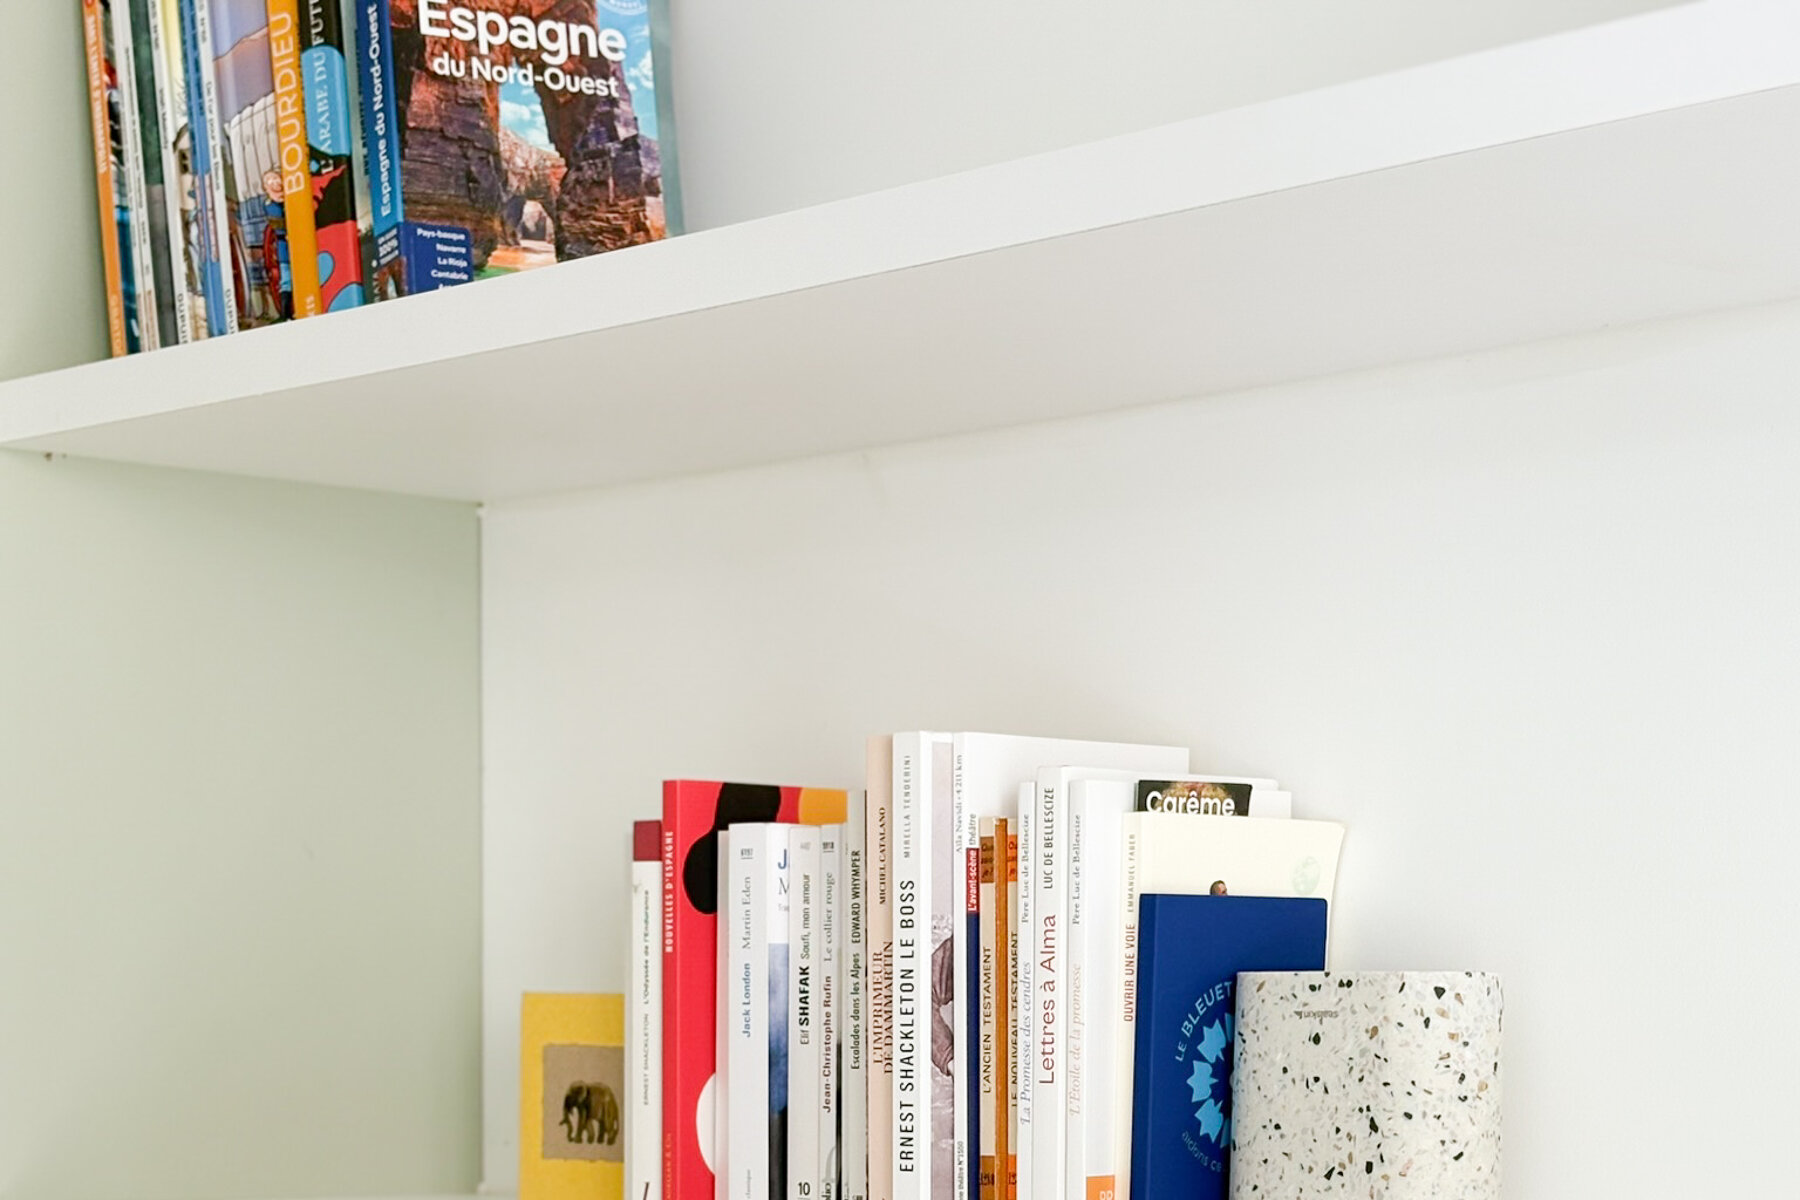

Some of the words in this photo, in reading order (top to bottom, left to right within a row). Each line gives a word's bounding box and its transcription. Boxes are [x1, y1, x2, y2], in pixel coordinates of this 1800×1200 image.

[418, 0, 628, 65] Espagne
[313, 52, 327, 83] DU
[367, 4, 383, 111] Nord-Ouest
[432, 52, 465, 78] du
[471, 55, 620, 98] Nord-Ouest
[270, 12, 305, 195] BOURDIEU
[376, 112, 387, 135] du
[377, 138, 392, 217] Espagne
[225, 288, 235, 335] DUPUI
[955, 754, 963, 771] km
[903, 755, 911, 811] TENDERINI
[1043, 787, 1055, 848] BELLESCIZE
[1146, 791, 1235, 816] Carême
[903, 814, 911, 858] MIRELLA
[968, 813, 977, 845] théâtre
[665, 831, 674, 890] D'ESPAGNE
[851, 849, 861, 900] WHYMPER
[1021, 865, 1030, 878] de
[1043, 852, 1054, 866] DE
[1072, 866, 1081, 878] de
[742, 876, 751, 904] Eden
[803, 873, 811, 904] amour
[823, 872, 836, 904] rouge
[1021, 880, 1030, 899] Luc
[1043, 869, 1054, 890] LUC
[1072, 881, 1081, 900] Luc
[1128, 865, 1136, 913] EMMANUEL
[803, 907, 811, 929] mon
[900, 880, 915, 928] BOSS
[665, 893, 674, 953] NOUVELLES
[742, 909, 751, 949] Martin
[822, 908, 833, 944] collier
[851, 902, 861, 944] EDWARD
[1125, 923, 1136, 950] VOIE
[823, 948, 833, 962] Le
[900, 938, 915, 959] LE
[1039, 914, 1057, 973] Alma
[850, 952, 861, 979] Alpes
[1124, 953, 1135, 975] UNE
[742, 963, 751, 1005] London
[798, 965, 810, 1026] SHAFAK
[823, 975, 832, 1006] Rufin
[850, 981, 861, 995] les
[883, 941, 893, 1047] DAMMARTIN
[983, 946, 992, 1025] TESTAMENT
[1019, 962, 1032, 1012] cendres
[1039, 980, 1056, 992] à
[1071, 964, 1084, 1026] promesse
[1123, 978, 1134, 1022] OUVRIR
[742, 1009, 751, 1038] Jack
[850, 998, 861, 1020] dans
[872, 952, 883, 1065] L'IMPRIMEUR
[1019, 1015, 1031, 1037] des
[1180, 981, 1233, 1038] BLEUET
[800, 1029, 810, 1045] Elif
[850, 1022, 861, 1069] Escalades
[900, 968, 915, 1092] SHACKLETON
[1039, 997, 1056, 1084] Lettres
[1070, 1029, 1081, 1041] la
[822, 1010, 833, 1114] Jean-Christophe
[884, 1051, 893, 1075] DE
[983, 1033, 992, 1093] L'ANCIEN
[1070, 1046, 1081, 1060] de
[1175, 1040, 1188, 1062] LE
[1020, 1041, 1031, 1103] Promesse
[1020, 1107, 1031, 1125] La
[900, 1100, 914, 1172] ERNEST
[798, 1182, 811, 1196] 10
